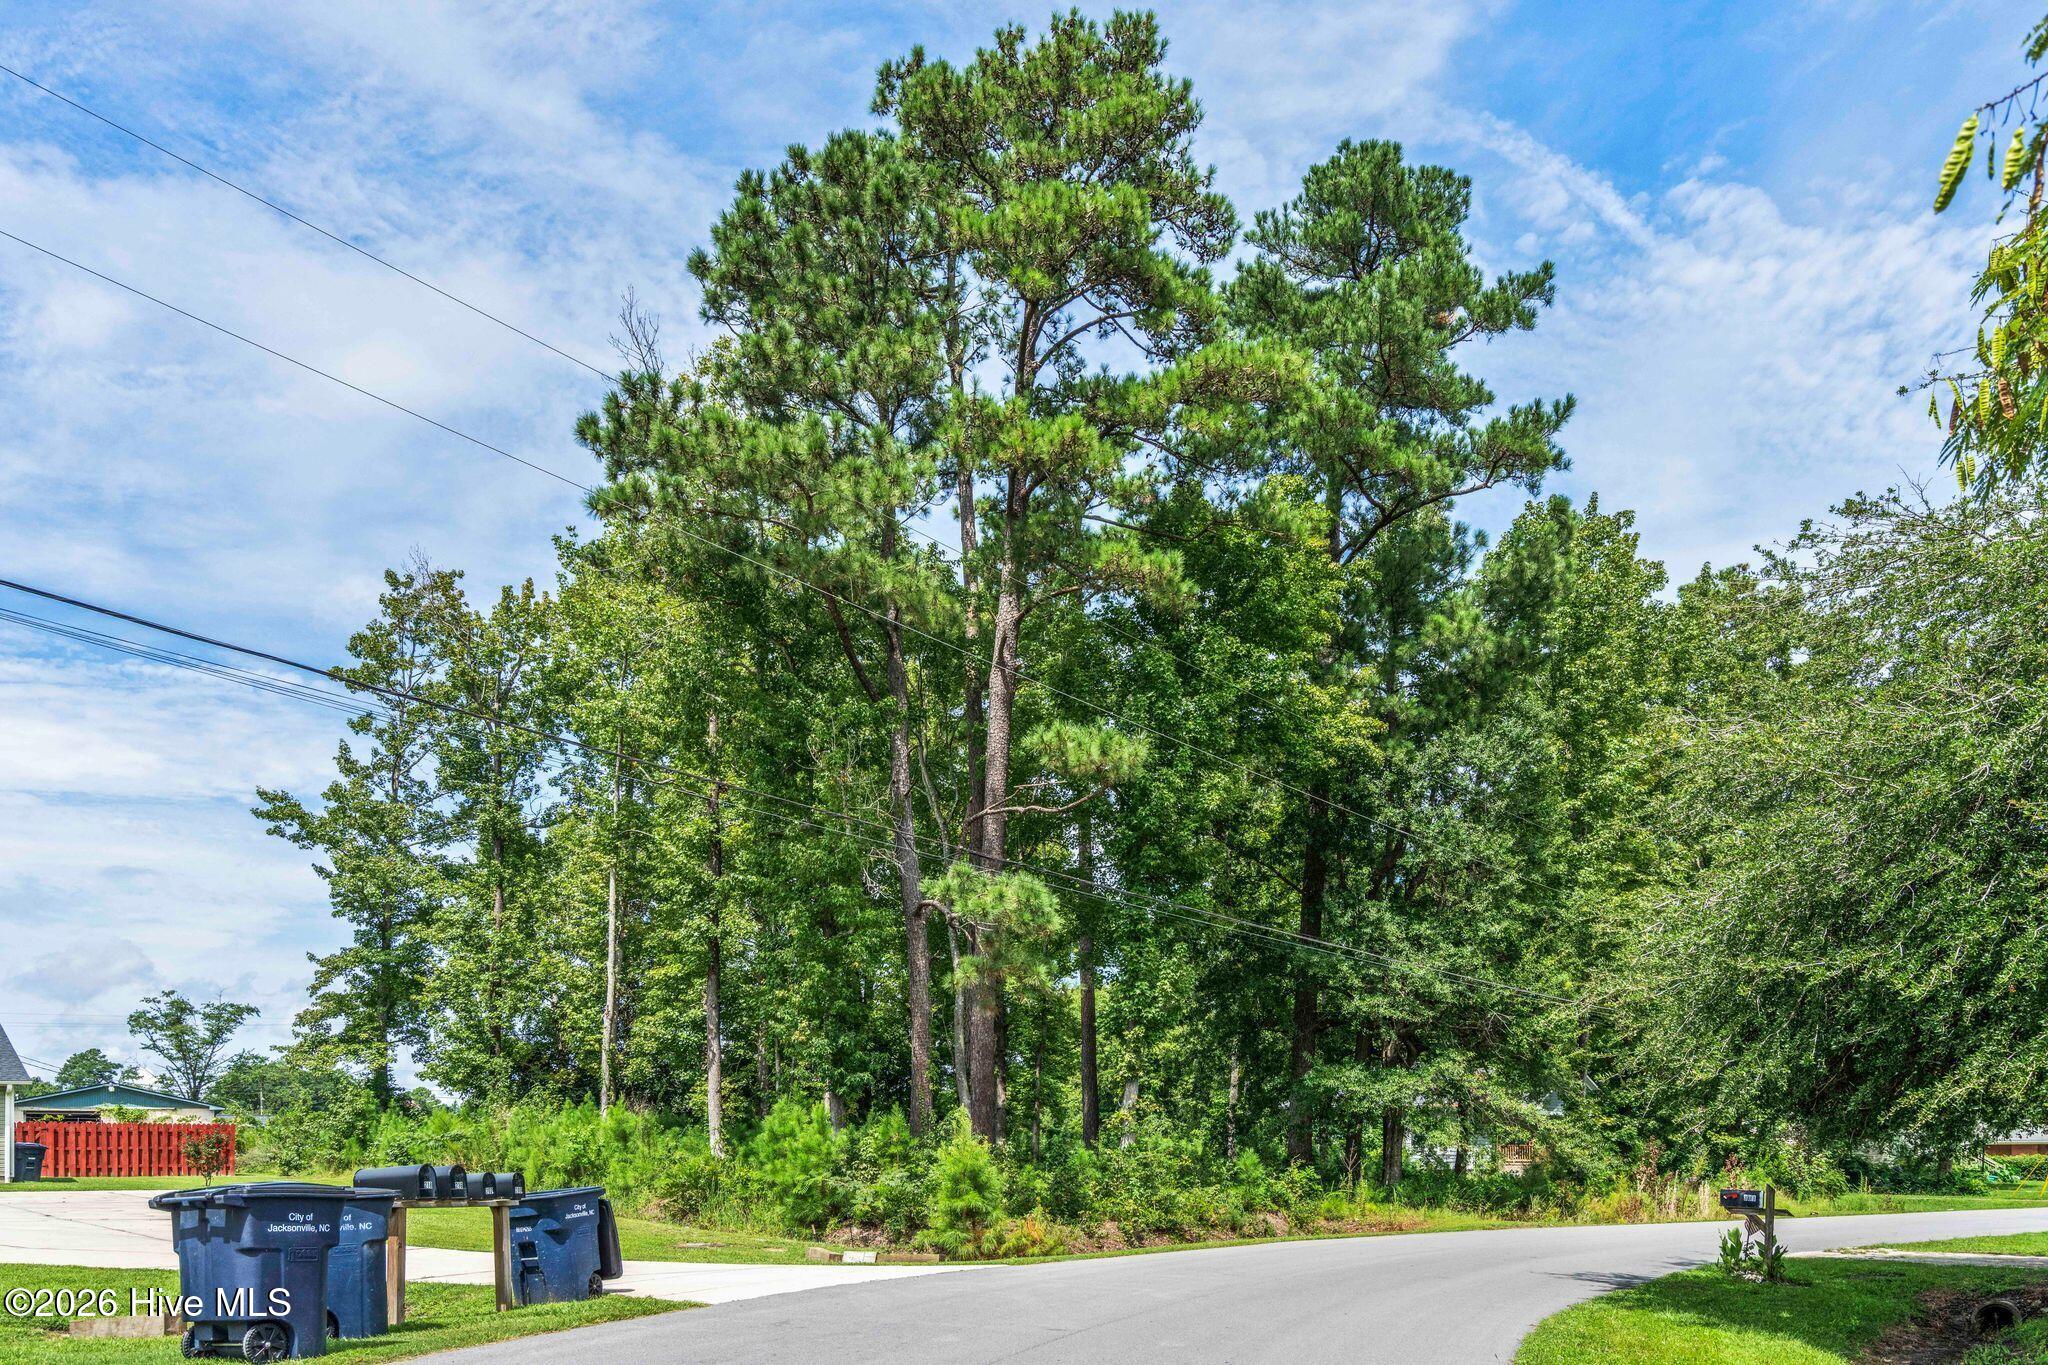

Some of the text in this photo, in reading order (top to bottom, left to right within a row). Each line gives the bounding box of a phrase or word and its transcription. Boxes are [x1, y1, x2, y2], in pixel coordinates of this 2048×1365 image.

[288, 1212, 314, 1223] City of
[267, 1224, 331, 1233] Jacksonville, NC
[359, 1222, 373, 1230] NC
